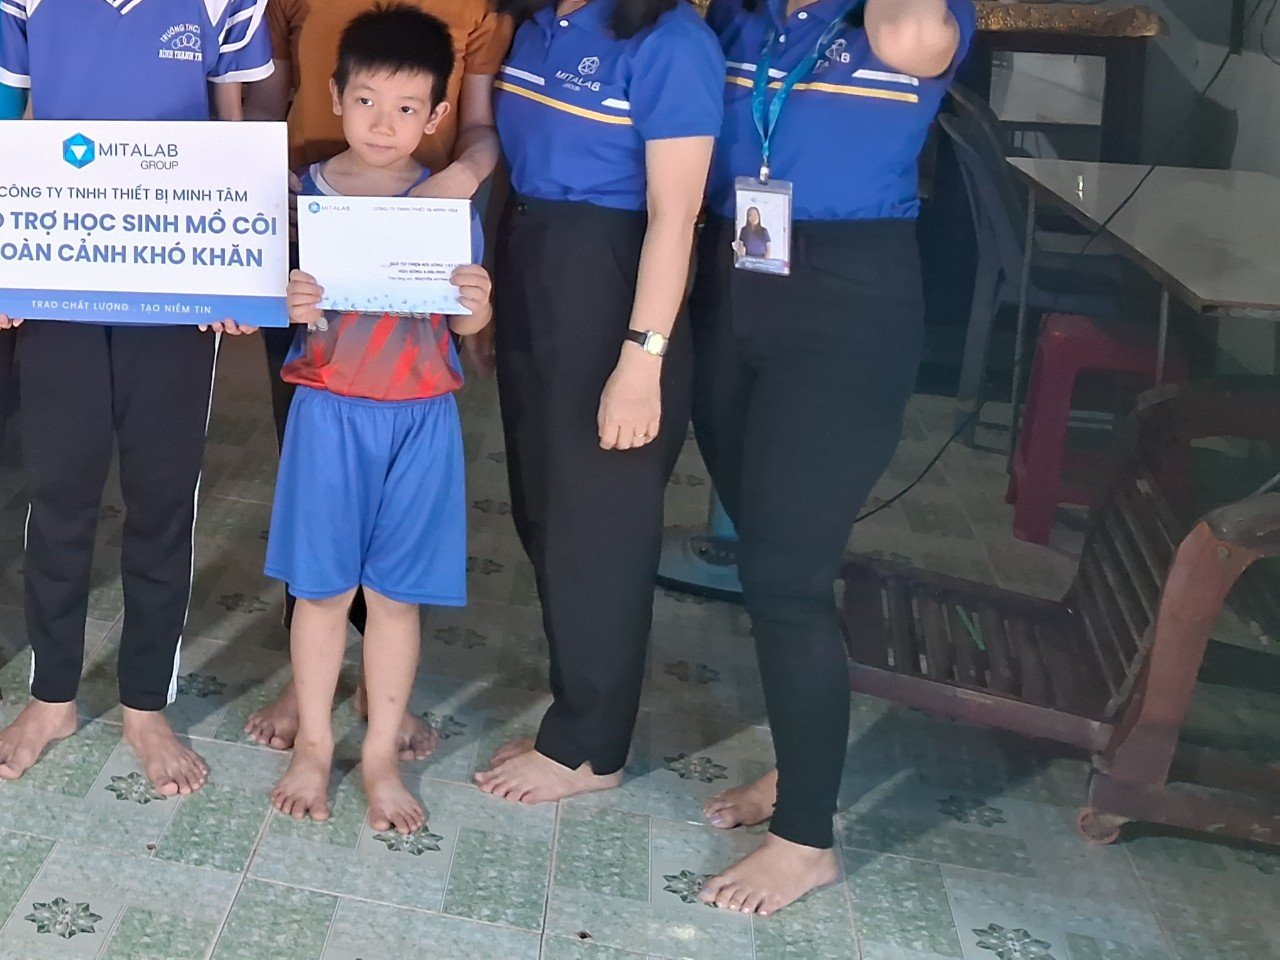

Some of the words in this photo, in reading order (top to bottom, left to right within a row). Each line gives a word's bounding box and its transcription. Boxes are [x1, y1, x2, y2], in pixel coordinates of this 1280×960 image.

[555, 70, 601, 92] MITALAB
[99, 143, 178, 158] MITALAB
[140, 160, 179, 170] GROUP
[46, 187, 63, 198] TY
[67, 187, 107, 199] TNHH
[112, 184, 150, 200] THIẾT
[155, 188, 168, 203] BỊ
[172, 189, 212, 202] MINH
[217, 187, 248, 202] TÂM
[10, 210, 58, 235] TRỢ
[63, 213, 116, 236] HỌC
[122, 214, 179, 233] SINH
[186, 209, 227, 234] MỒ
[232, 212, 277, 235] CÔI
[58, 238, 127, 263] CẢNH
[133, 241, 186, 264] KHÓ
[192, 243, 263, 267] KHĂN
[31, 300, 58, 309] TRAO
[62, 299, 89, 310] CHẤT
[93, 301, 129, 313] LƯỢNG
[140, 303, 160, 314] TẠO
[194, 305, 211, 314] TIN
